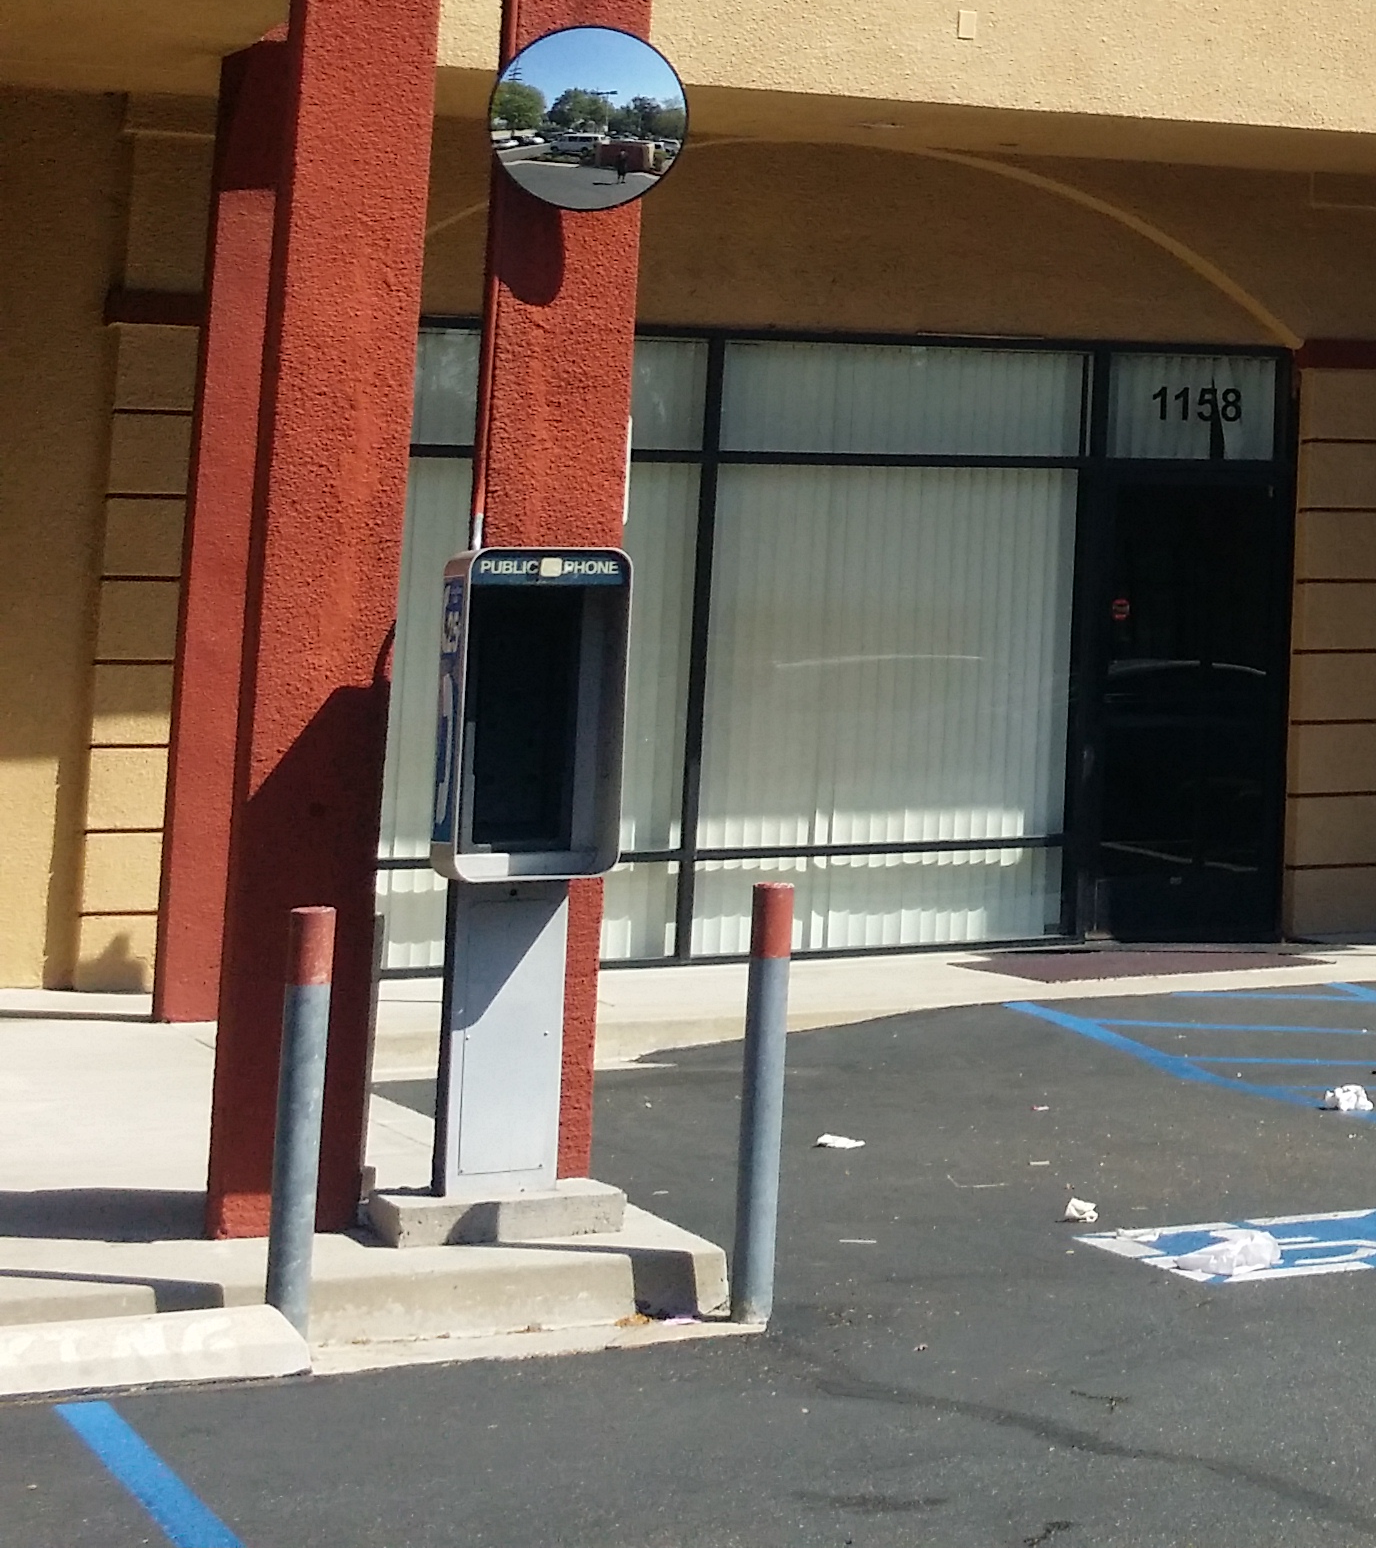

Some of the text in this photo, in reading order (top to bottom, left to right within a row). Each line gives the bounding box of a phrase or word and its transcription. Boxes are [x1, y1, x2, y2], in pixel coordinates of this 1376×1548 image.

[1152, 386, 1242, 422] 1158
[480, 559, 619, 575] PUBLIC PHONE
